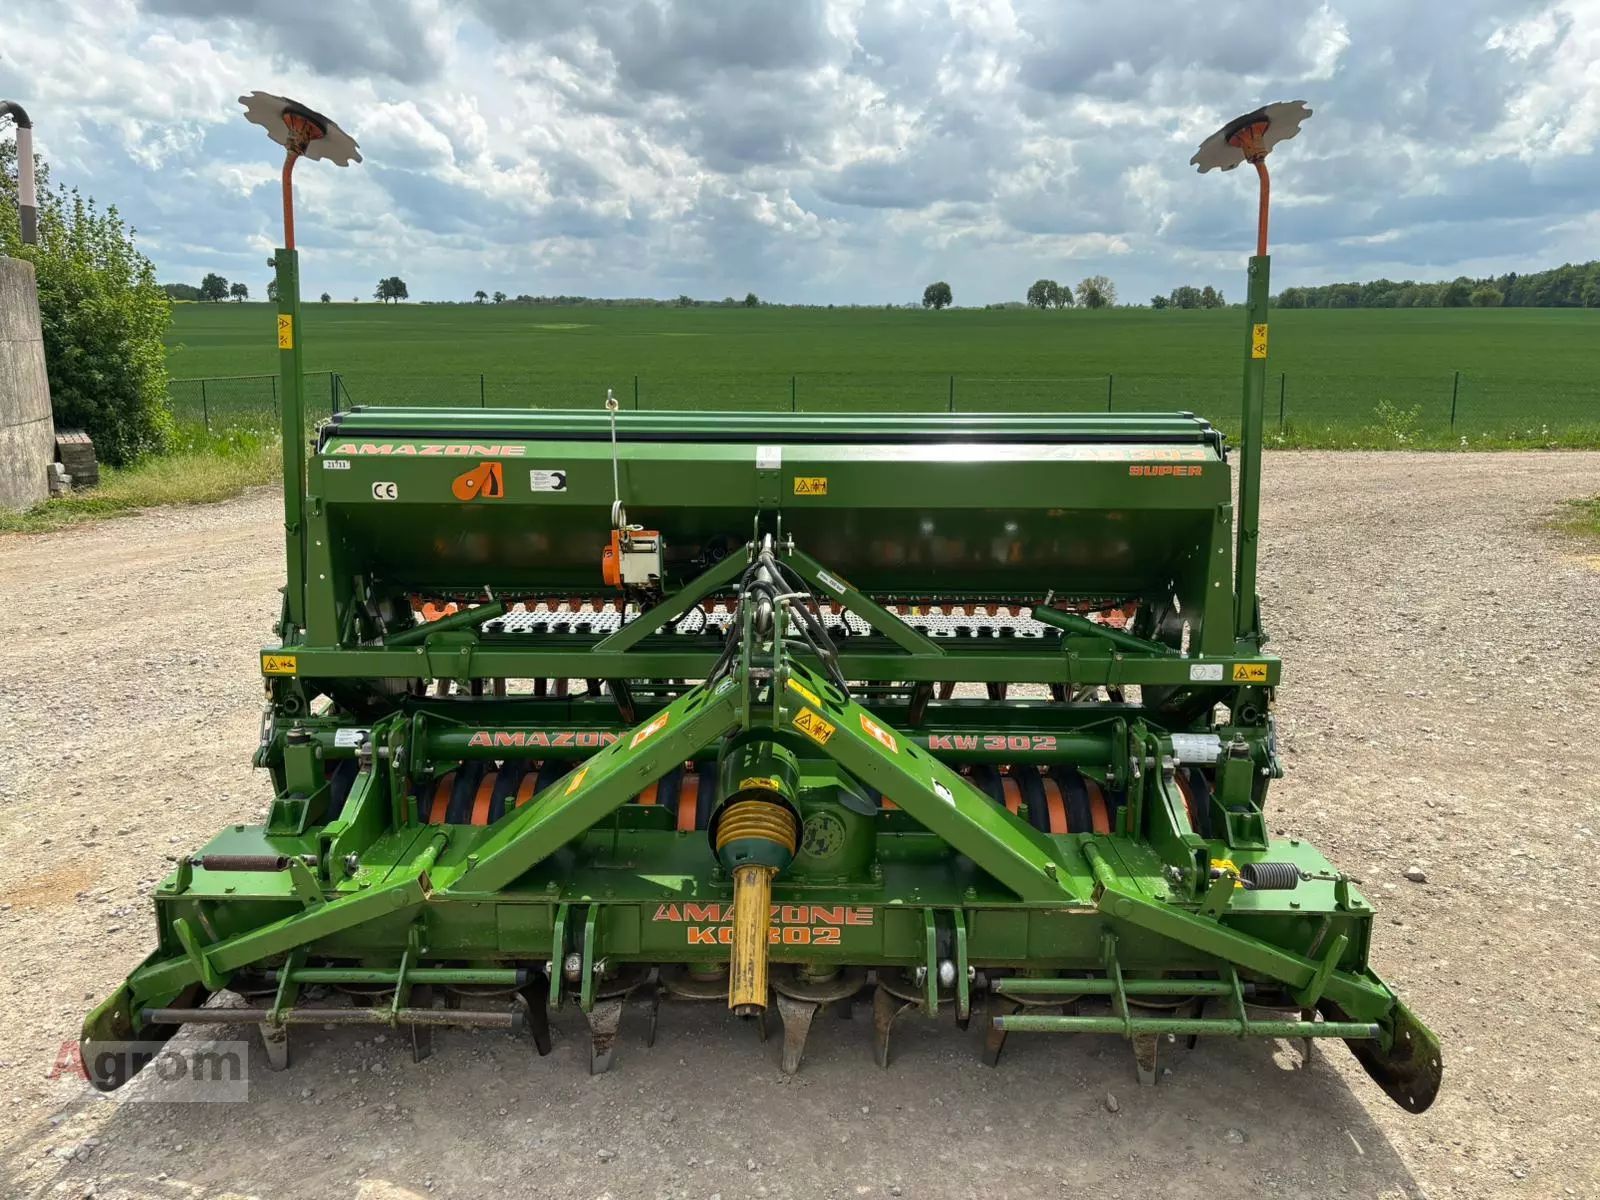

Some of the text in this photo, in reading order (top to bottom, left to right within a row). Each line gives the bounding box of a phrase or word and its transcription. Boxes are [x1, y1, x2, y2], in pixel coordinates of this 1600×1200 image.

[331, 443, 527, 457] AMAZONE
[1129, 465, 1203, 478] SUPER
[373, 483, 396, 499] CE
[468, 731, 627, 748] AMAZON
[928, 734, 1058, 751] KW 302
